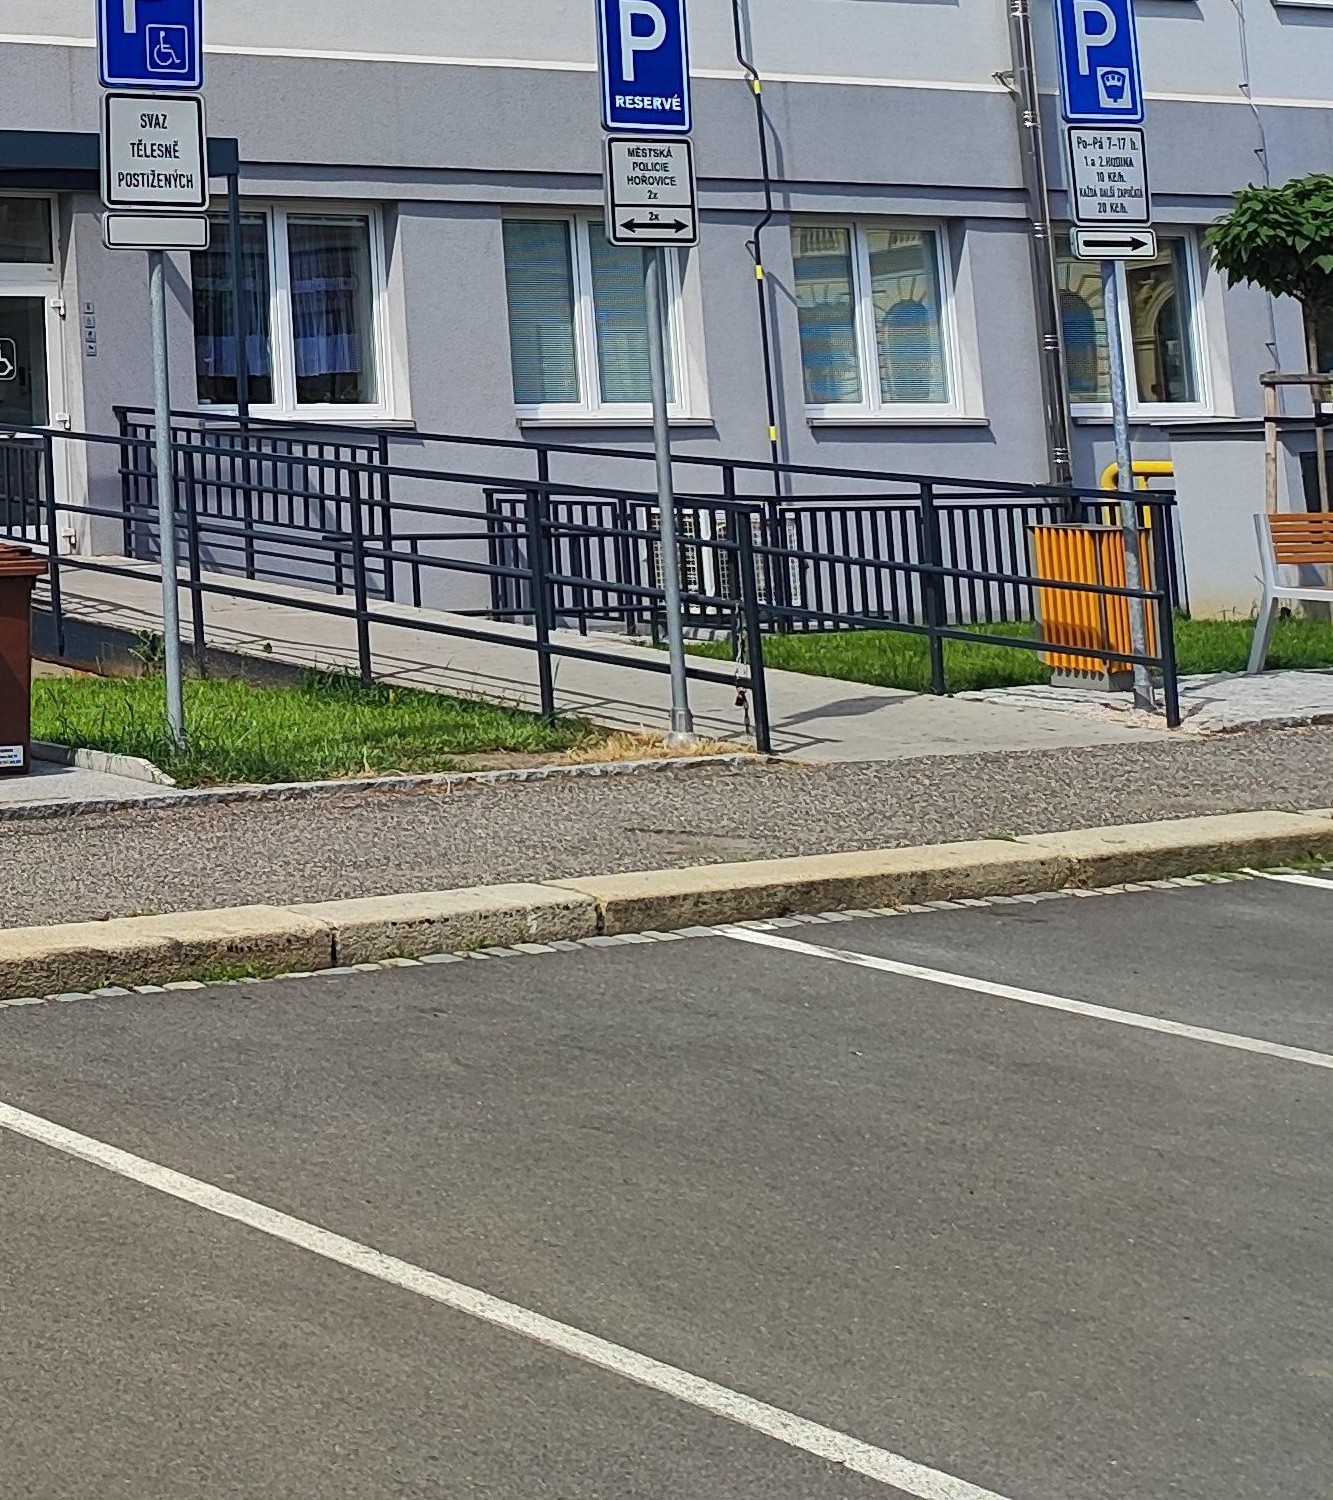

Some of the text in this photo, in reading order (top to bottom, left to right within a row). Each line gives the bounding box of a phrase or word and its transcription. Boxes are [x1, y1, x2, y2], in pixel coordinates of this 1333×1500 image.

[619, 0, 666, 81] P
[1073, 0, 1116, 75] P
[615, 94, 681, 110] RESERVÉ
[140, 113, 167, 129] SVAZ
[130, 139, 180, 159] TĚLESNĚ
[1077, 136, 1103, 150] Po-Pá
[1107, 137, 1126, 150] 7-17
[627, 147, 673, 158] MĚSTSKÁ
[632, 162, 669, 172] POLICIE
[117, 169, 193, 189] POSTIŽENÝCH
[627, 174, 676, 186] HOŘOVICE
[1098, 202, 1106, 213] 20
